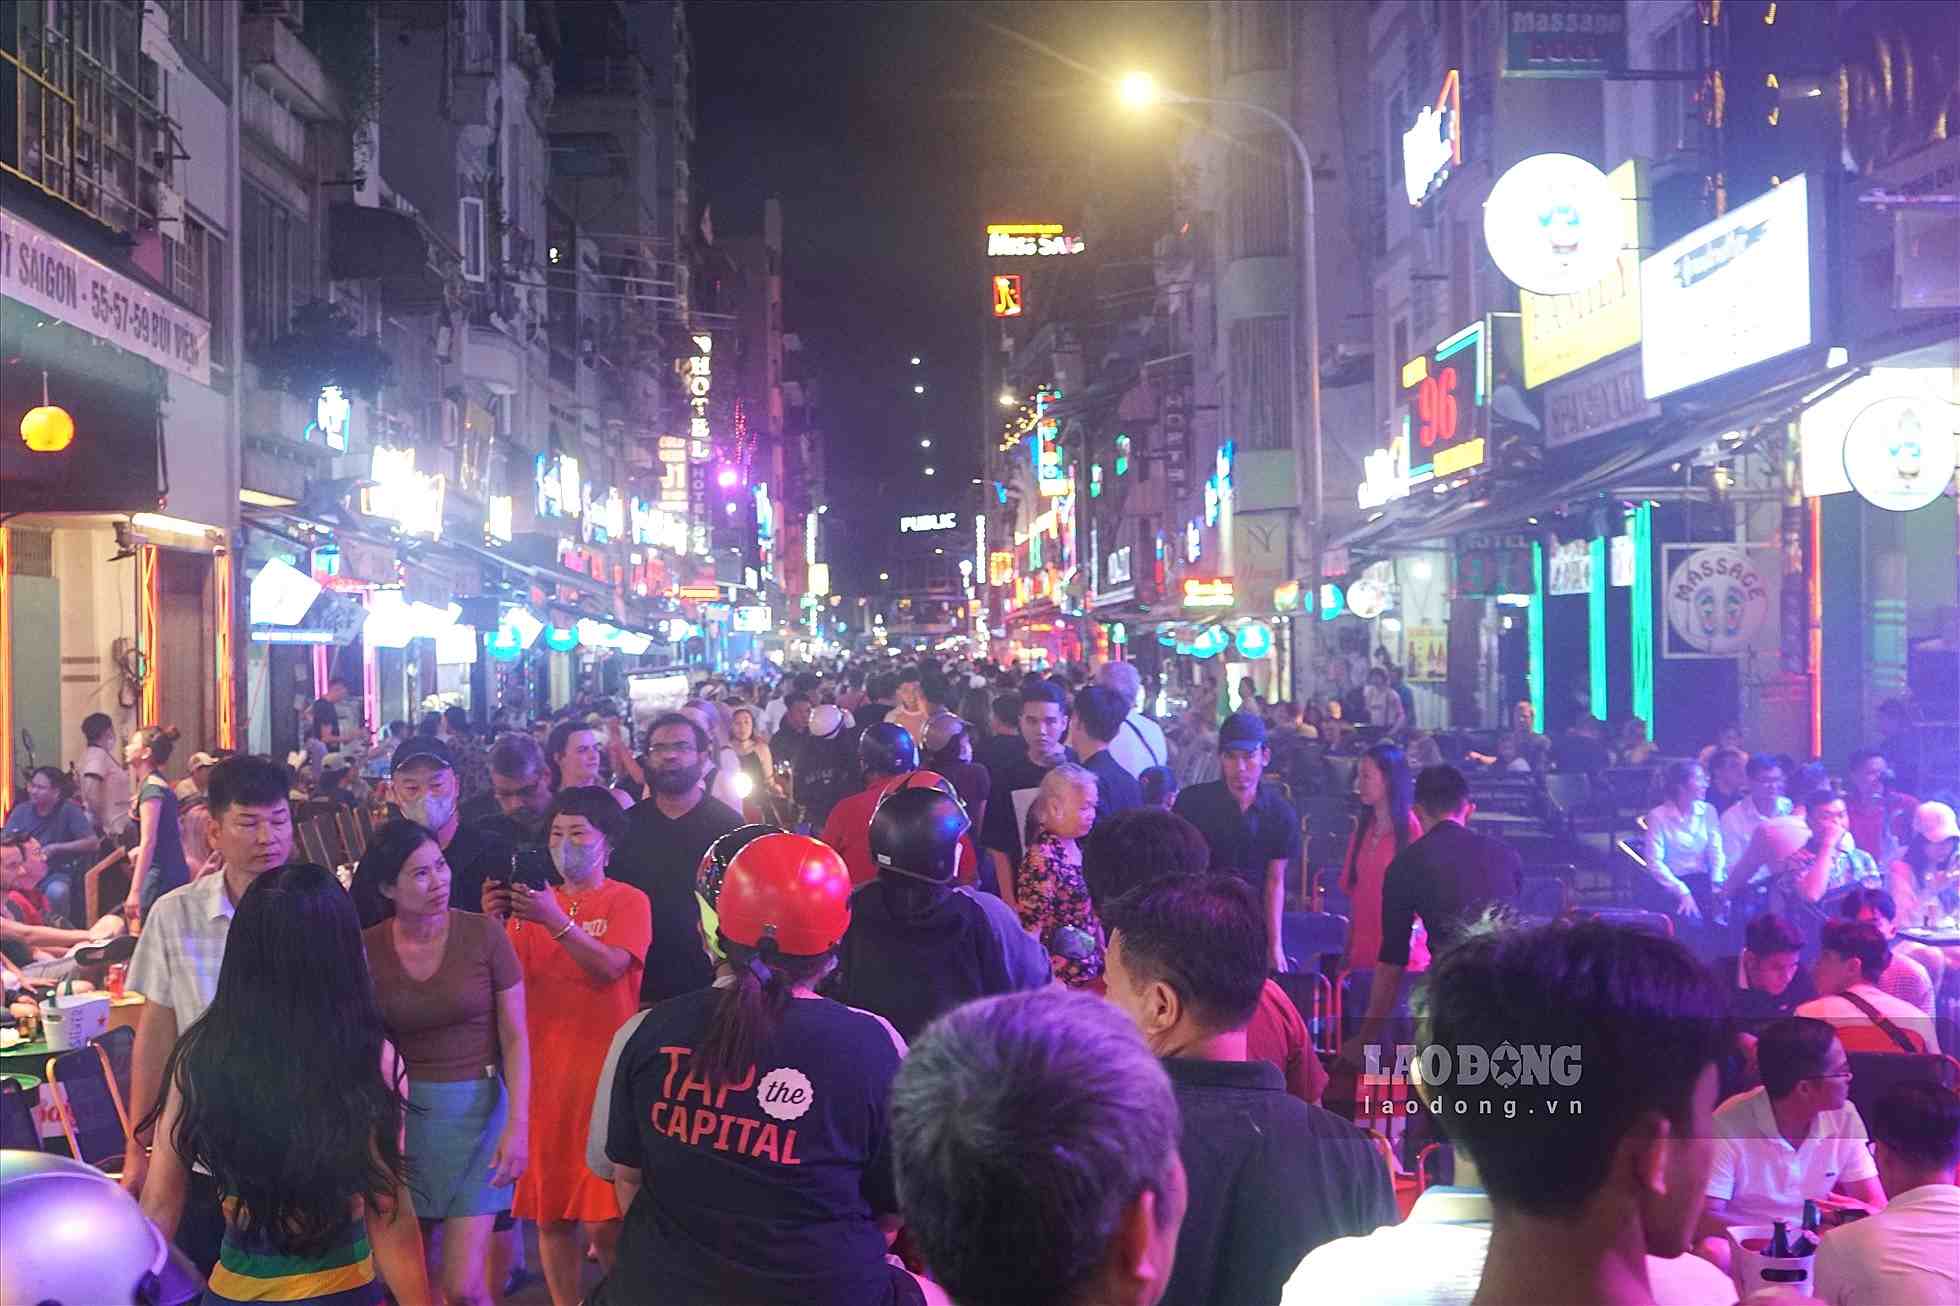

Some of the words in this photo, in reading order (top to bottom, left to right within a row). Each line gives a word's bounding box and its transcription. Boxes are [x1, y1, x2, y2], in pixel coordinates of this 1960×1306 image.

[19, 242, 77, 309] SAIGON
[91, 280, 149, 343] 55-57-59
[690, 356, 710, 459] HOTEL
[1419, 368, 1457, 447] 96
[1674, 557, 1767, 602] MASSAGE
[658, 1046, 757, 1109] TAP
[765, 1080, 806, 1105] the
[651, 1101, 801, 1165] CAPITAL
